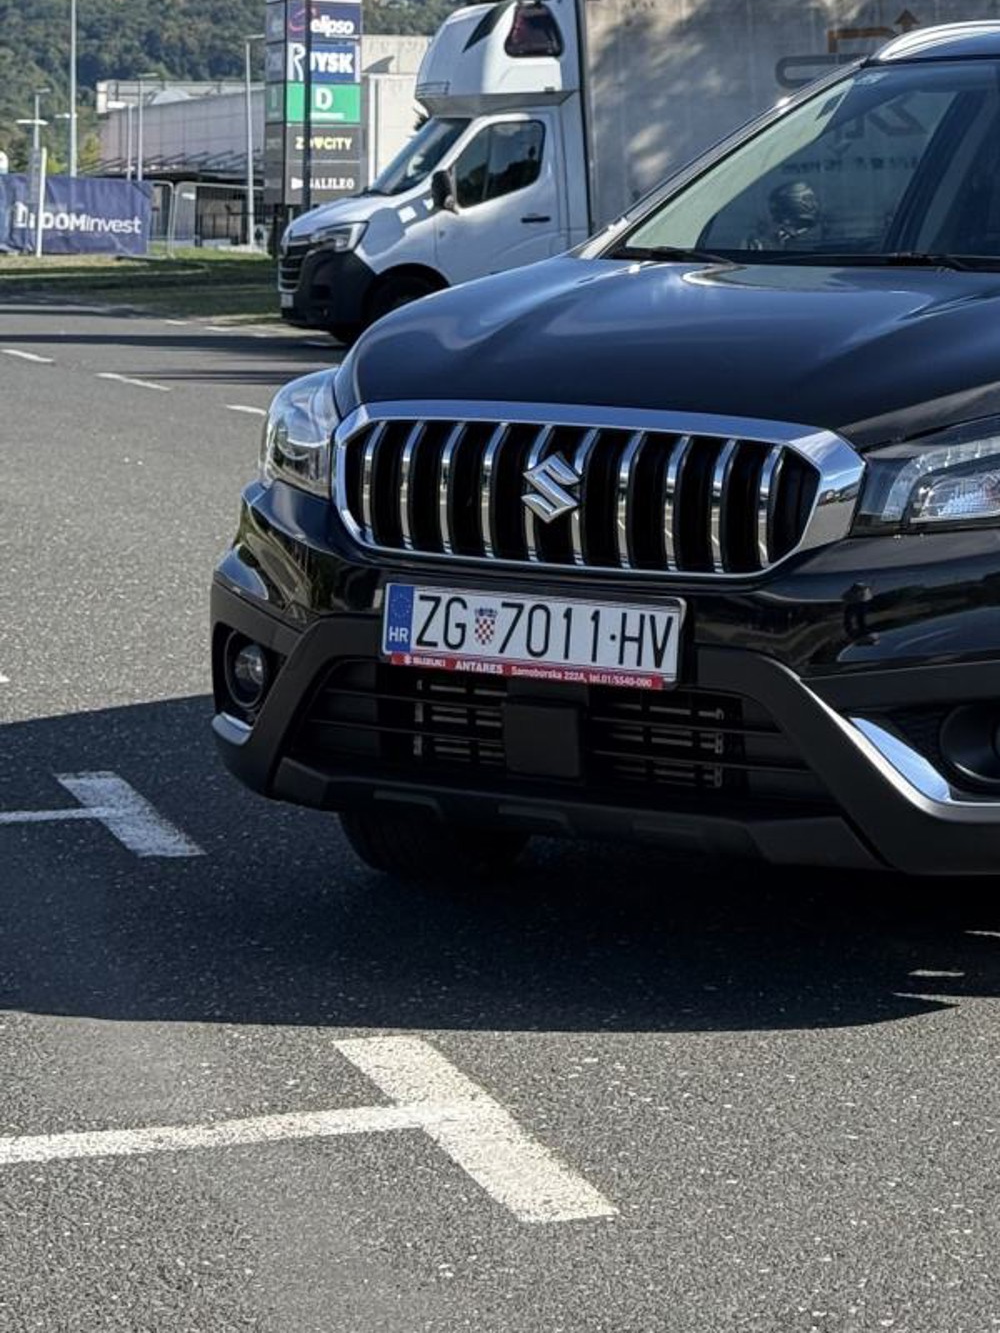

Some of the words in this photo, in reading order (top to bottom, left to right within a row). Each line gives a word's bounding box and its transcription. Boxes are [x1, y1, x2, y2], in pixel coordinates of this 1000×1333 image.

[310, 15, 354, 37] elipso
[309, 177, 355, 190] ALILEO
[416, 595, 468, 650] ZG
[388, 626, 409, 643] HR
[454, 660, 504, 674] ANTARES
